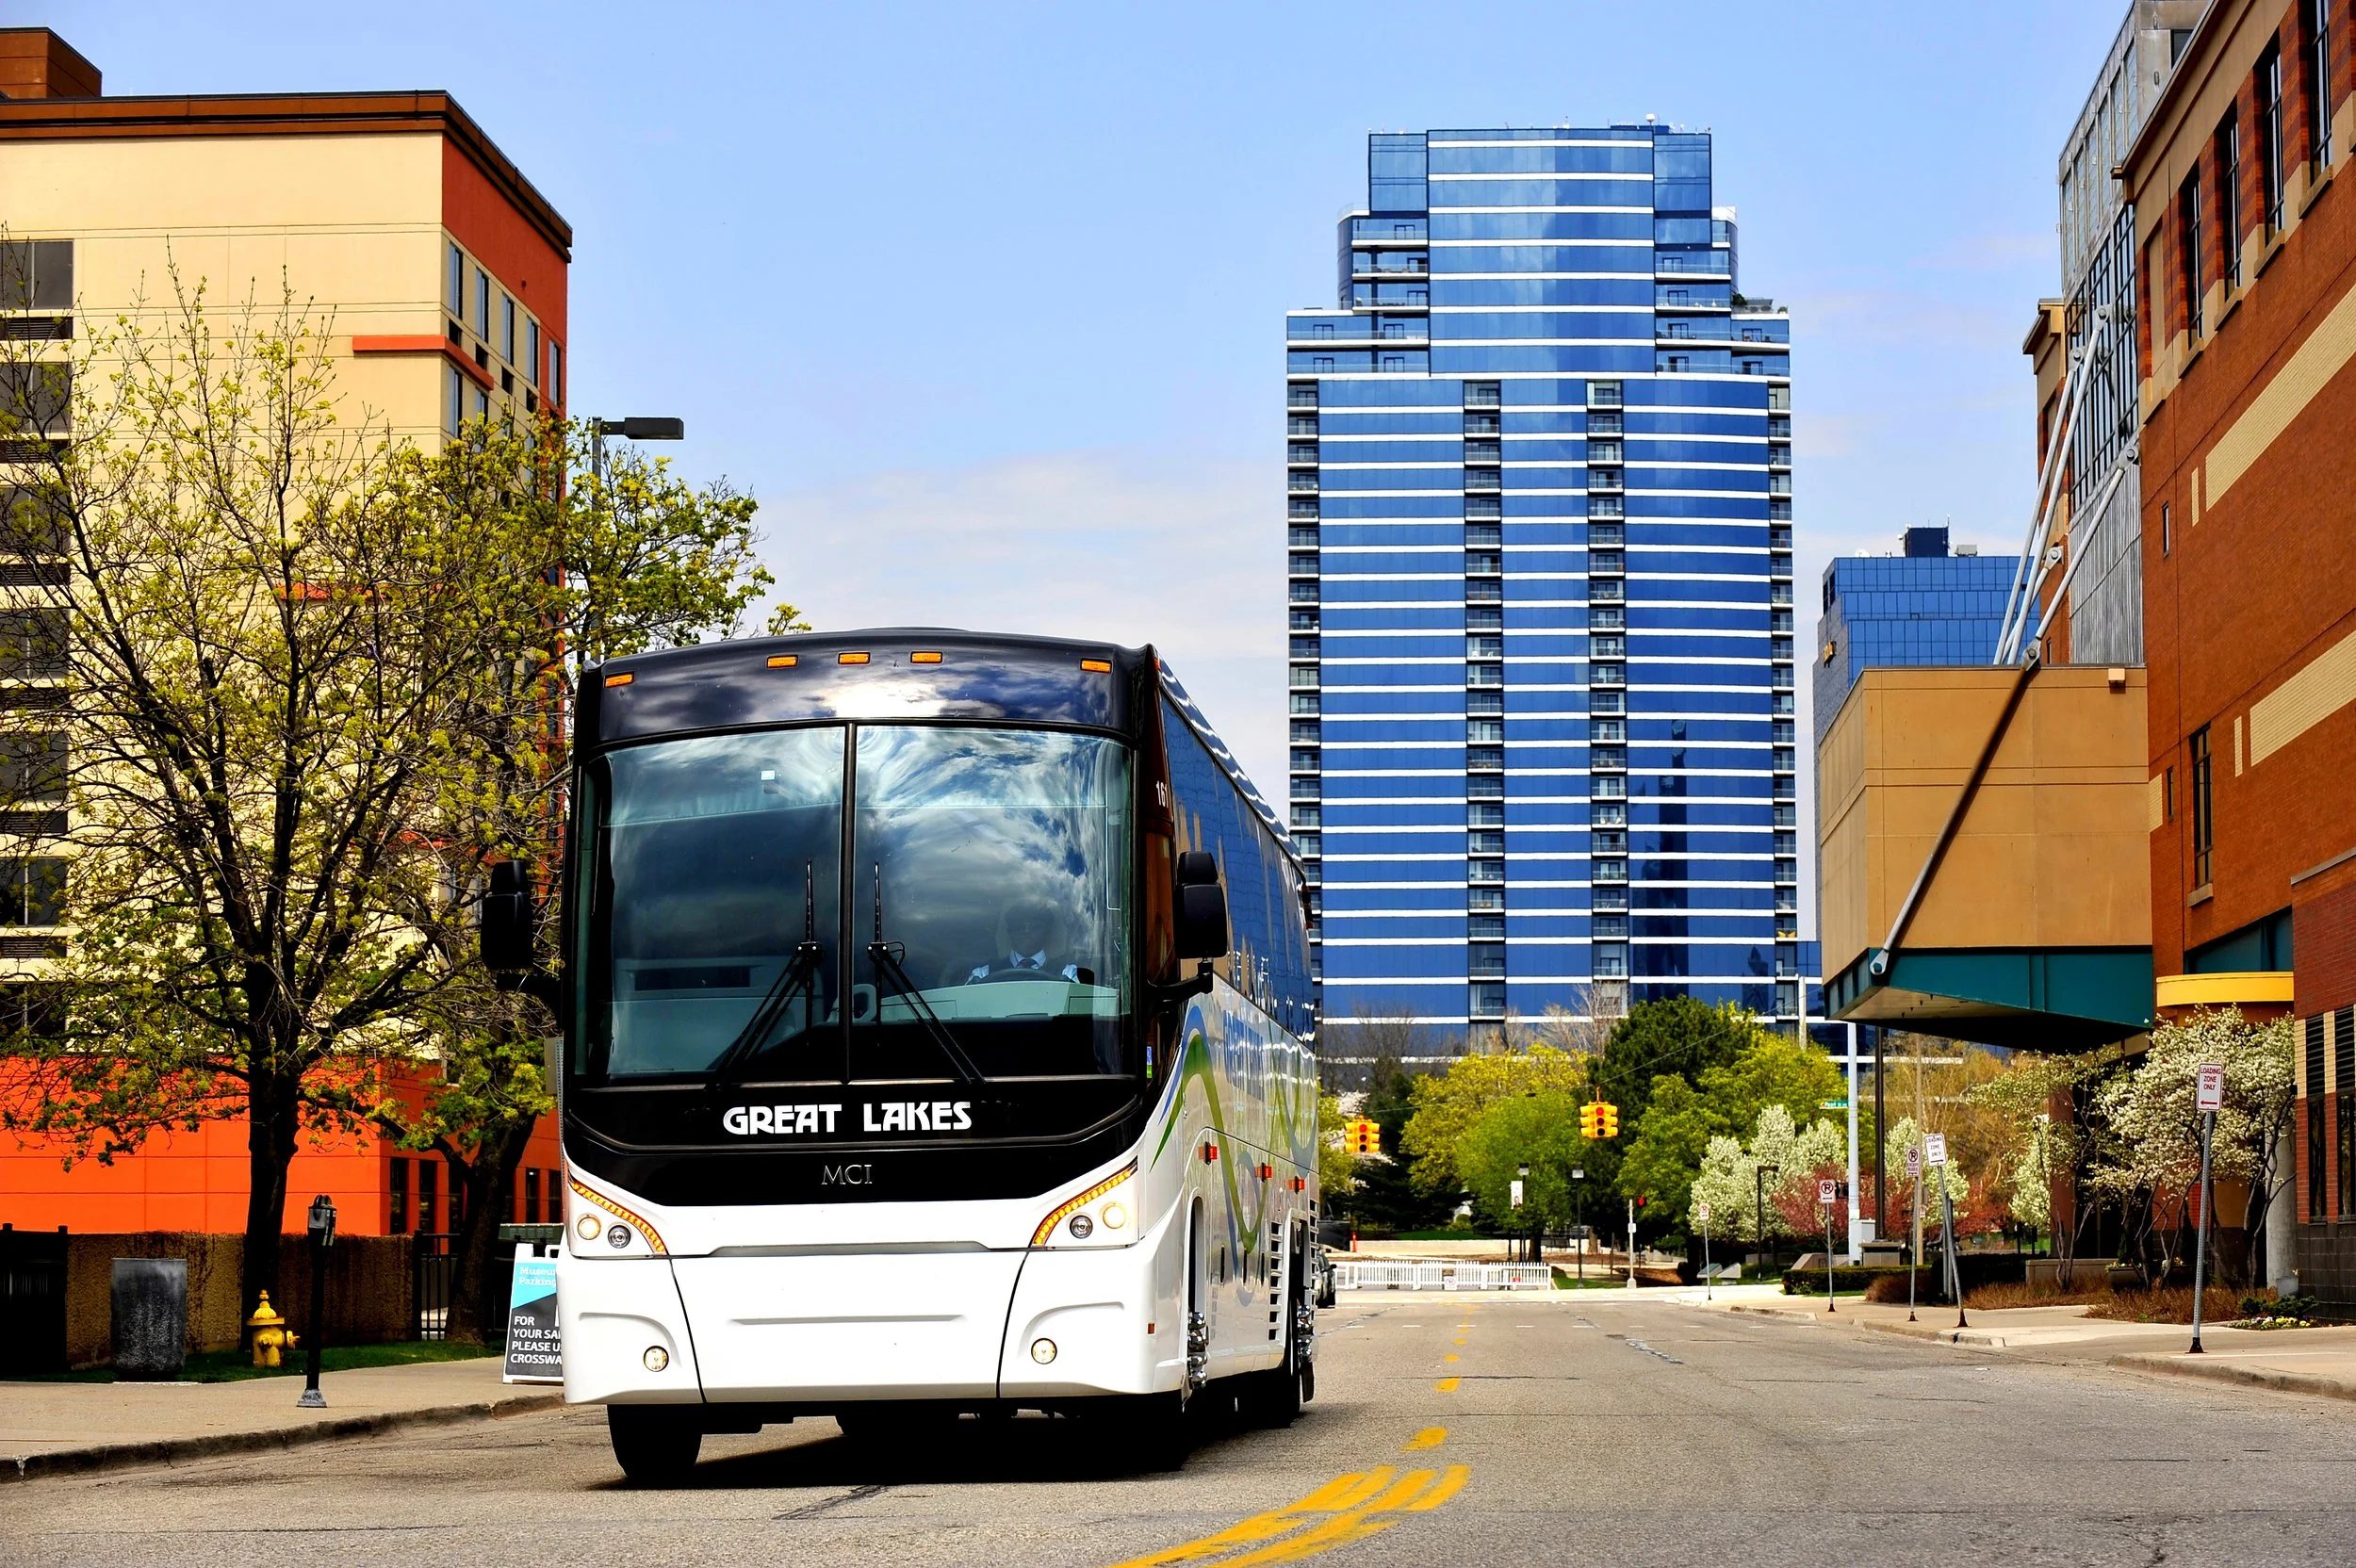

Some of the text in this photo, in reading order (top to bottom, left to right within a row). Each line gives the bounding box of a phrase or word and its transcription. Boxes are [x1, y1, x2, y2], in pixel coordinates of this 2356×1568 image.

[723, 1102, 972, 1135] GREAT LAKES
[821, 1164, 873, 1184] MCI
[514, 1315, 535, 1326] FOR
[513, 1328, 543, 1338] YOUR
[512, 1340, 551, 1351] PLEASE
